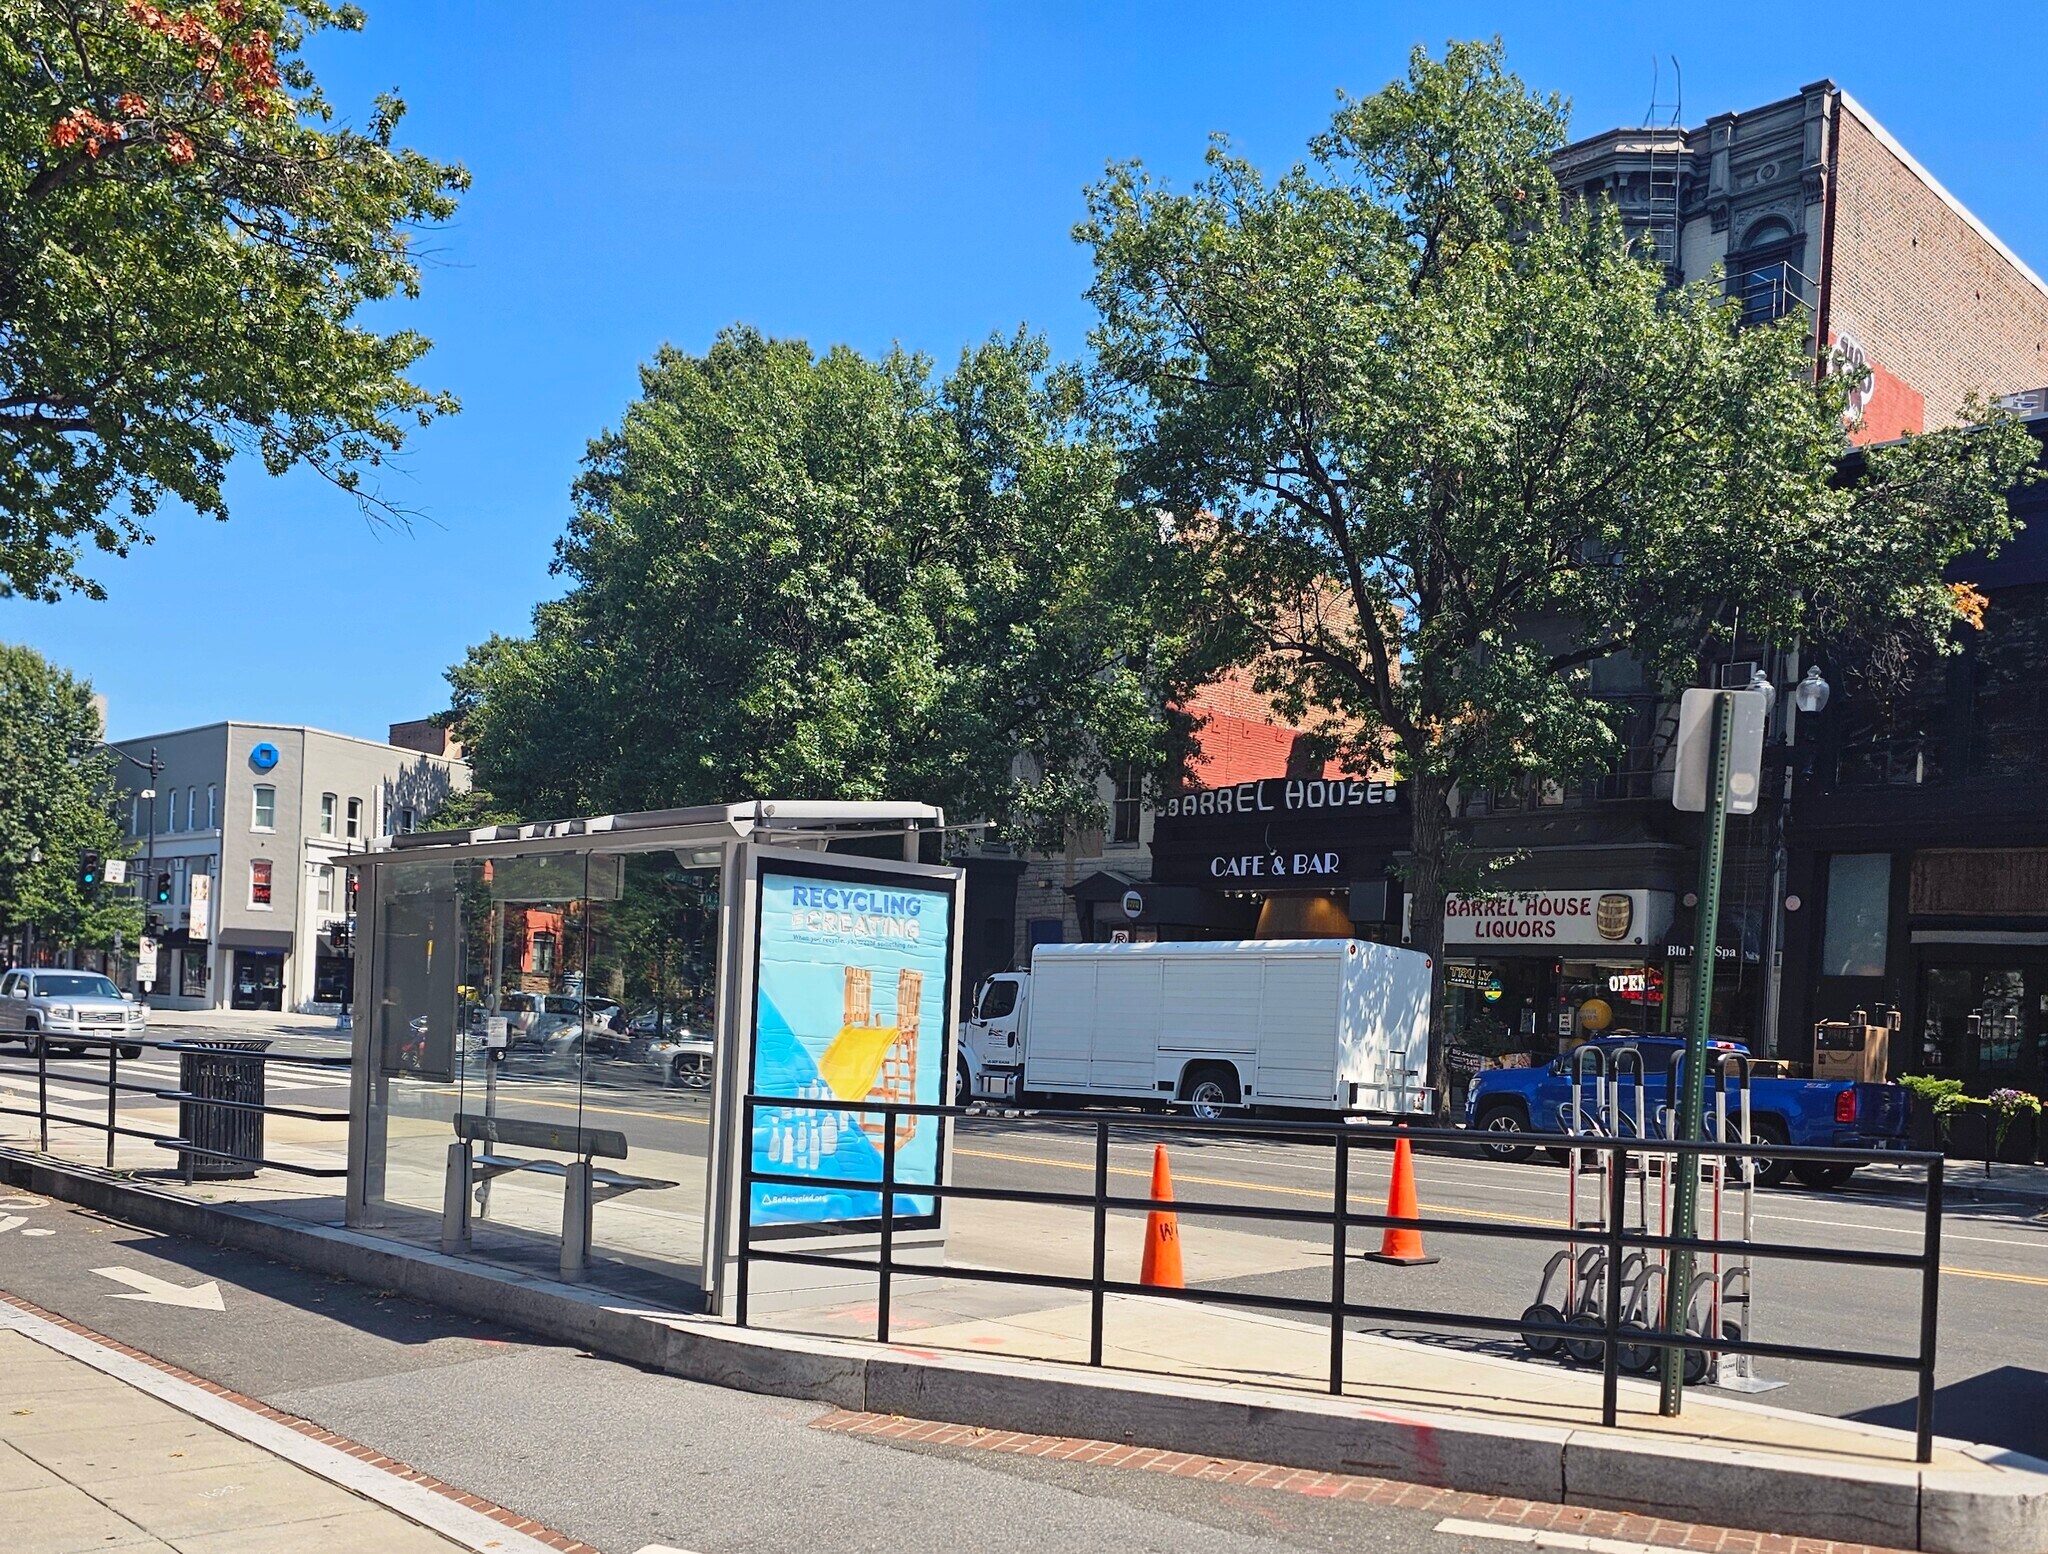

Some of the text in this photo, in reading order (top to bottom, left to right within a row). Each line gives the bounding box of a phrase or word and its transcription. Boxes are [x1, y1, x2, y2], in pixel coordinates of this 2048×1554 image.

[1168, 780, 1383, 817] BARREL HOUSE
[1211, 852, 1340, 877] CAFE & BAR
[792, 885, 922, 917] RECYCLING
[1446, 897, 1592, 917] BARREL HOUSE
[1475, 919, 1556, 938] LIQUORS
[1667, 945, 1686, 956] Blu
[1715, 945, 1736, 959] Spa
[1450, 966, 1492, 981] TRULY
[1609, 975, 1646, 992] OPEN
